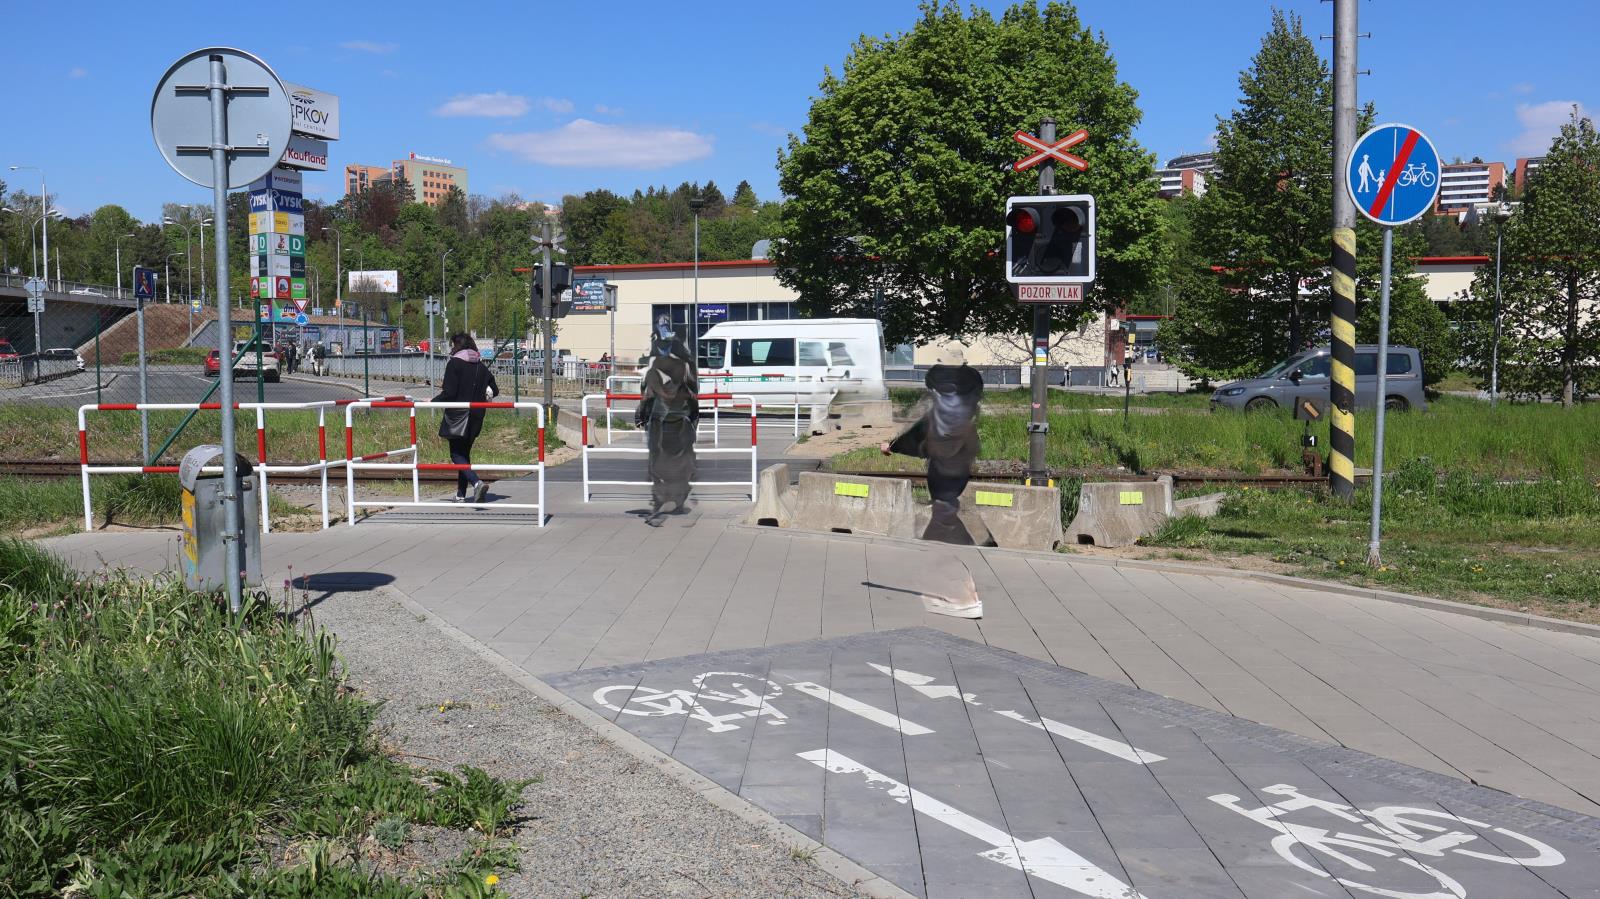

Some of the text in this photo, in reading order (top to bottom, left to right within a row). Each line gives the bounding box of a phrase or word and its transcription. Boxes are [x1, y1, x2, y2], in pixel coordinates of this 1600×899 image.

[291, 104, 329, 125] PKOV
[288, 148, 326, 165] Kaufland
[253, 193, 267, 208] JYSK
[279, 195, 303, 208] JYSK
[292, 238, 302, 250] D
[1021, 287, 1078, 298] POZOR VLAK
[283, 303, 295, 312] dm
[1309, 436, 1314, 446] 1
